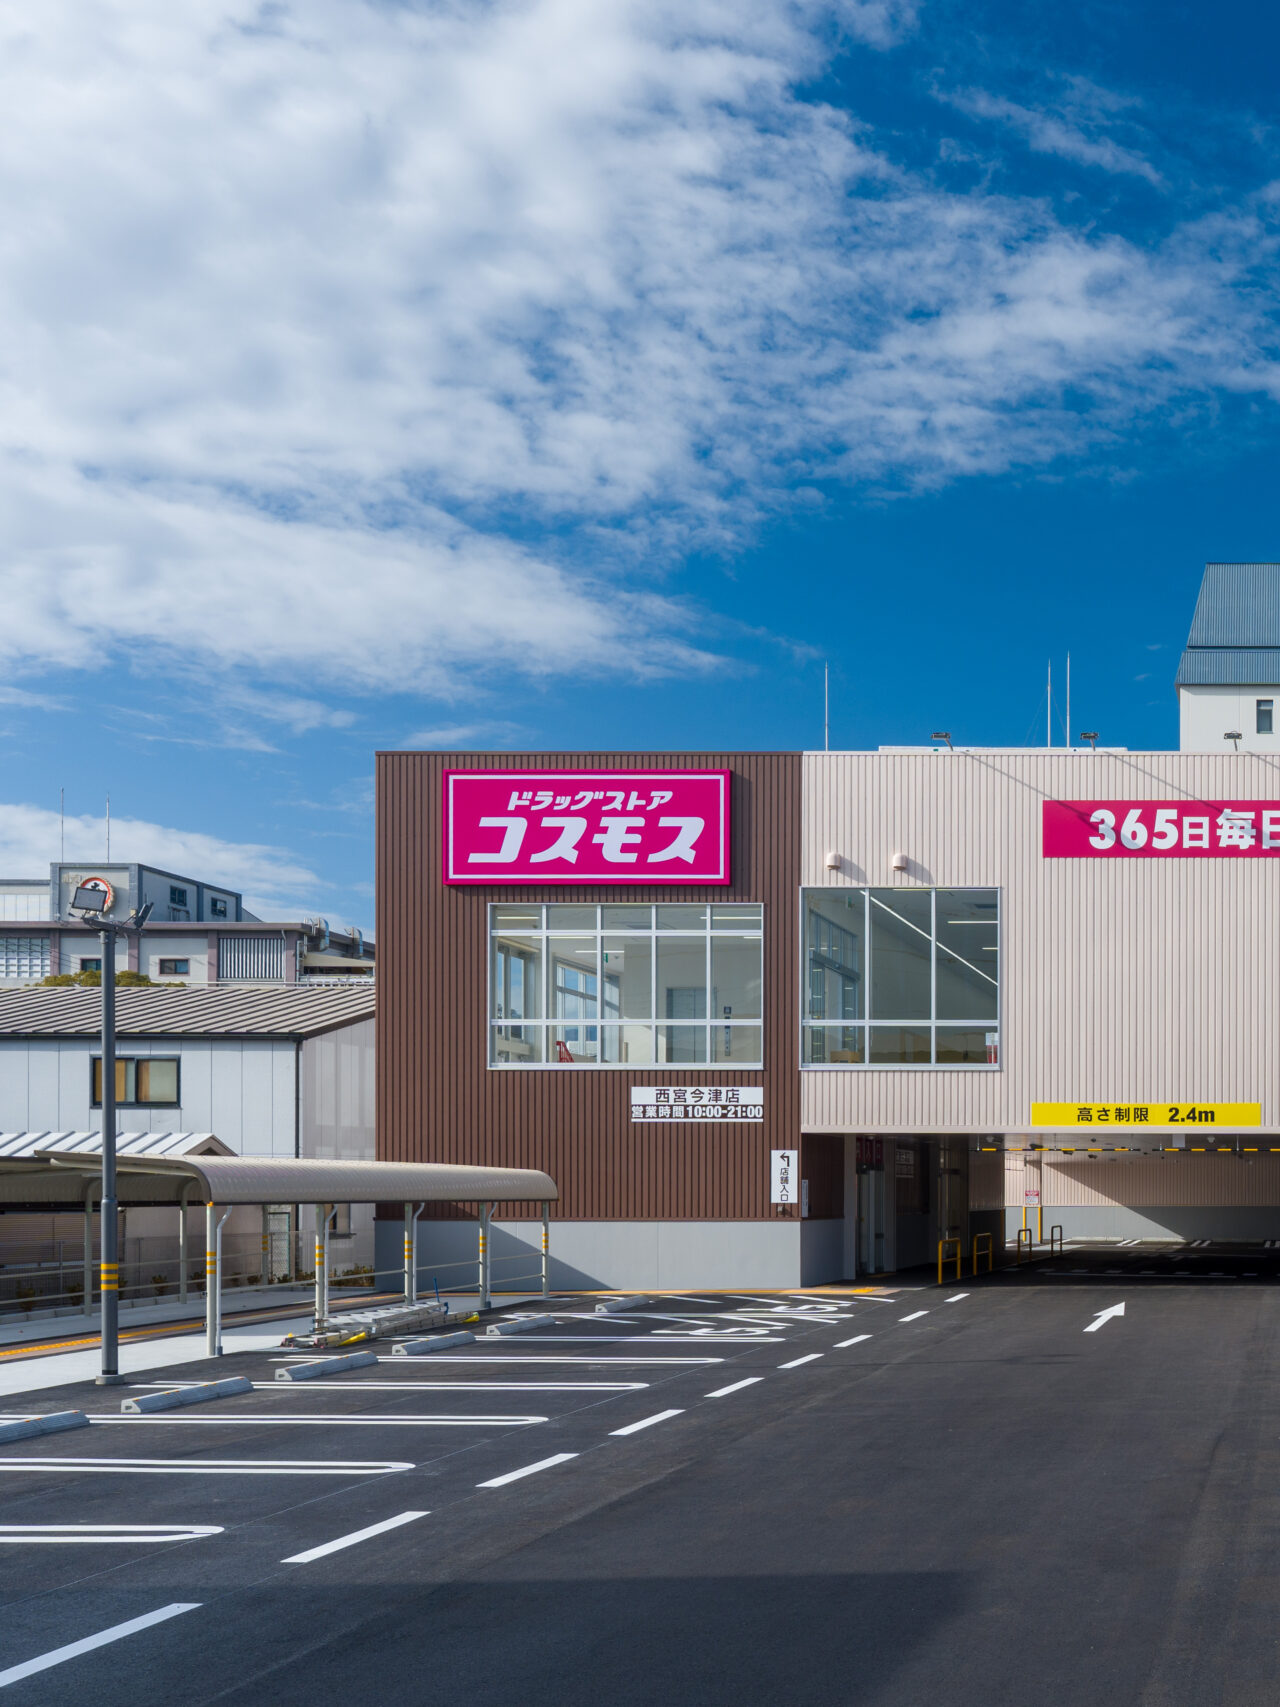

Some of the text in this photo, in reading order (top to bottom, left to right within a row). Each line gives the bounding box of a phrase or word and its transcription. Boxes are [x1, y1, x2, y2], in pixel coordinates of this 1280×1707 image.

[506, 790, 674, 812] ドラッグストア
[467, 816, 706, 865] コスモス
[655, 1088, 740, 1103] 西宮今津店
[1077, 1107, 1215, 1122] 高さ制限 2.4m
[779, 1168, 789, 1201] 店舗入口
